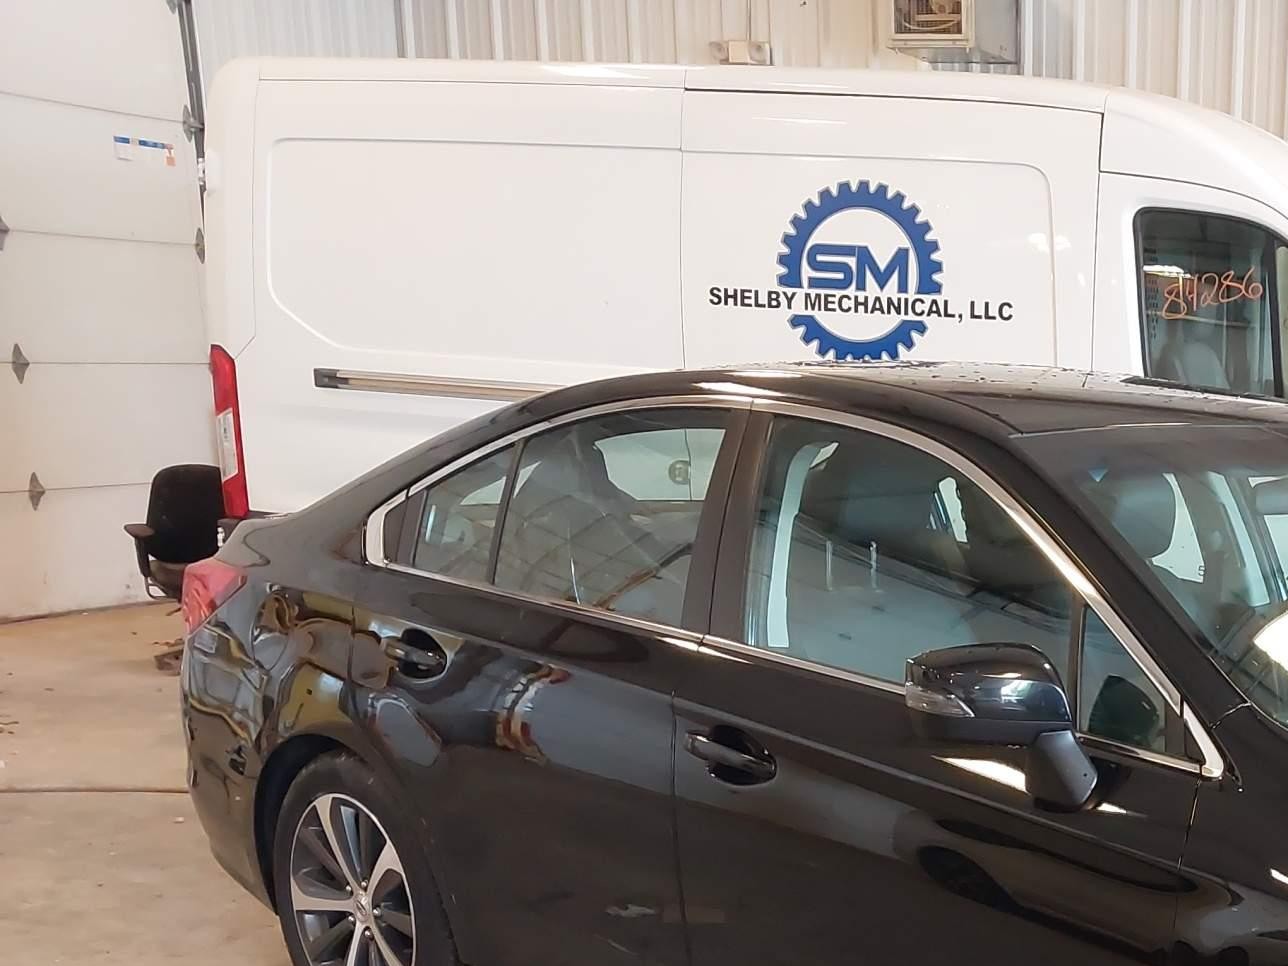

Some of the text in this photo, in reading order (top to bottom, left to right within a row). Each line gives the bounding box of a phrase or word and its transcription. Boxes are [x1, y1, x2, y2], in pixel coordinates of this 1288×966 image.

[806, 243, 911, 294] SM
[708, 286, 1014, 323] SHELBY MECHANICAL, LLC
